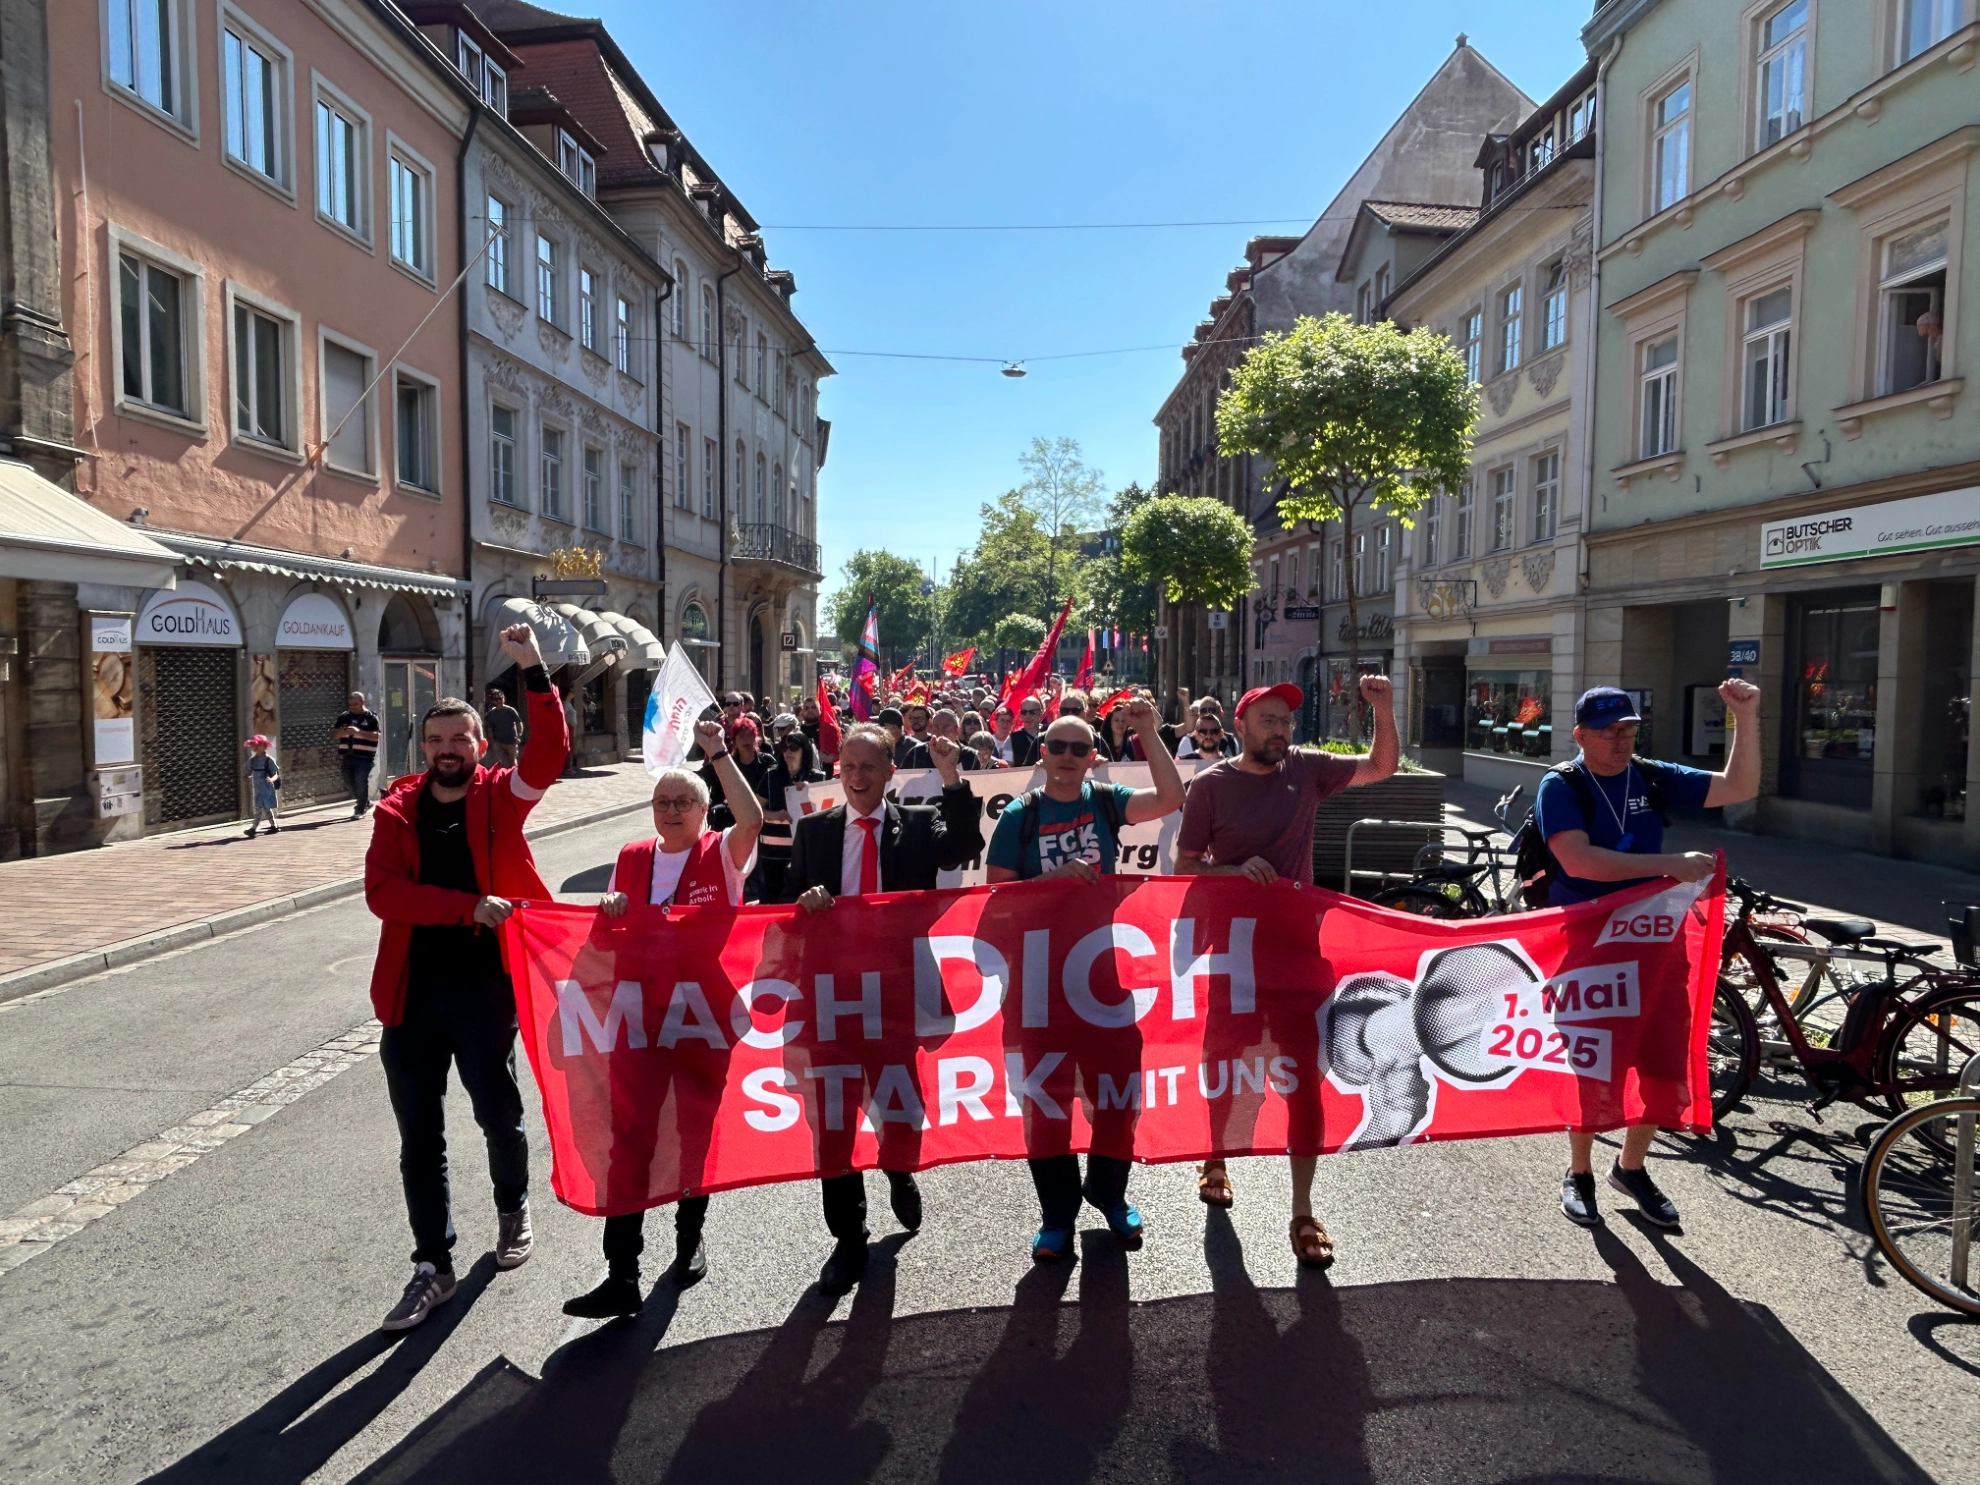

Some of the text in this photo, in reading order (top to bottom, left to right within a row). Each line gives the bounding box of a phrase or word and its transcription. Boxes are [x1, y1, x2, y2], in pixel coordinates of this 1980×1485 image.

[1786, 517, 1853, 540] BUTSCHER
[1877, 531, 1893, 542] Gut
[1925, 524, 1943, 536] Gut
[1786, 535, 1823, 554] OPTIK
[151, 606, 230, 636] GOLDHAUS
[283, 620, 345, 637] GOLDANKAUF
[1730, 649, 1757, 662] 38/40
[1039, 823, 1099, 857] FCK
[1041, 840, 1101, 873] NS
[709, 884, 718, 893] in
[1609, 914, 1675, 938] DGB
[555, 917, 1258, 1058] MACH DICH
[1504, 972, 1628, 1019] 1. Mai
[1487, 1023, 1600, 1070] 2025
[742, 1051, 1299, 1132] STARK MIT UNS
